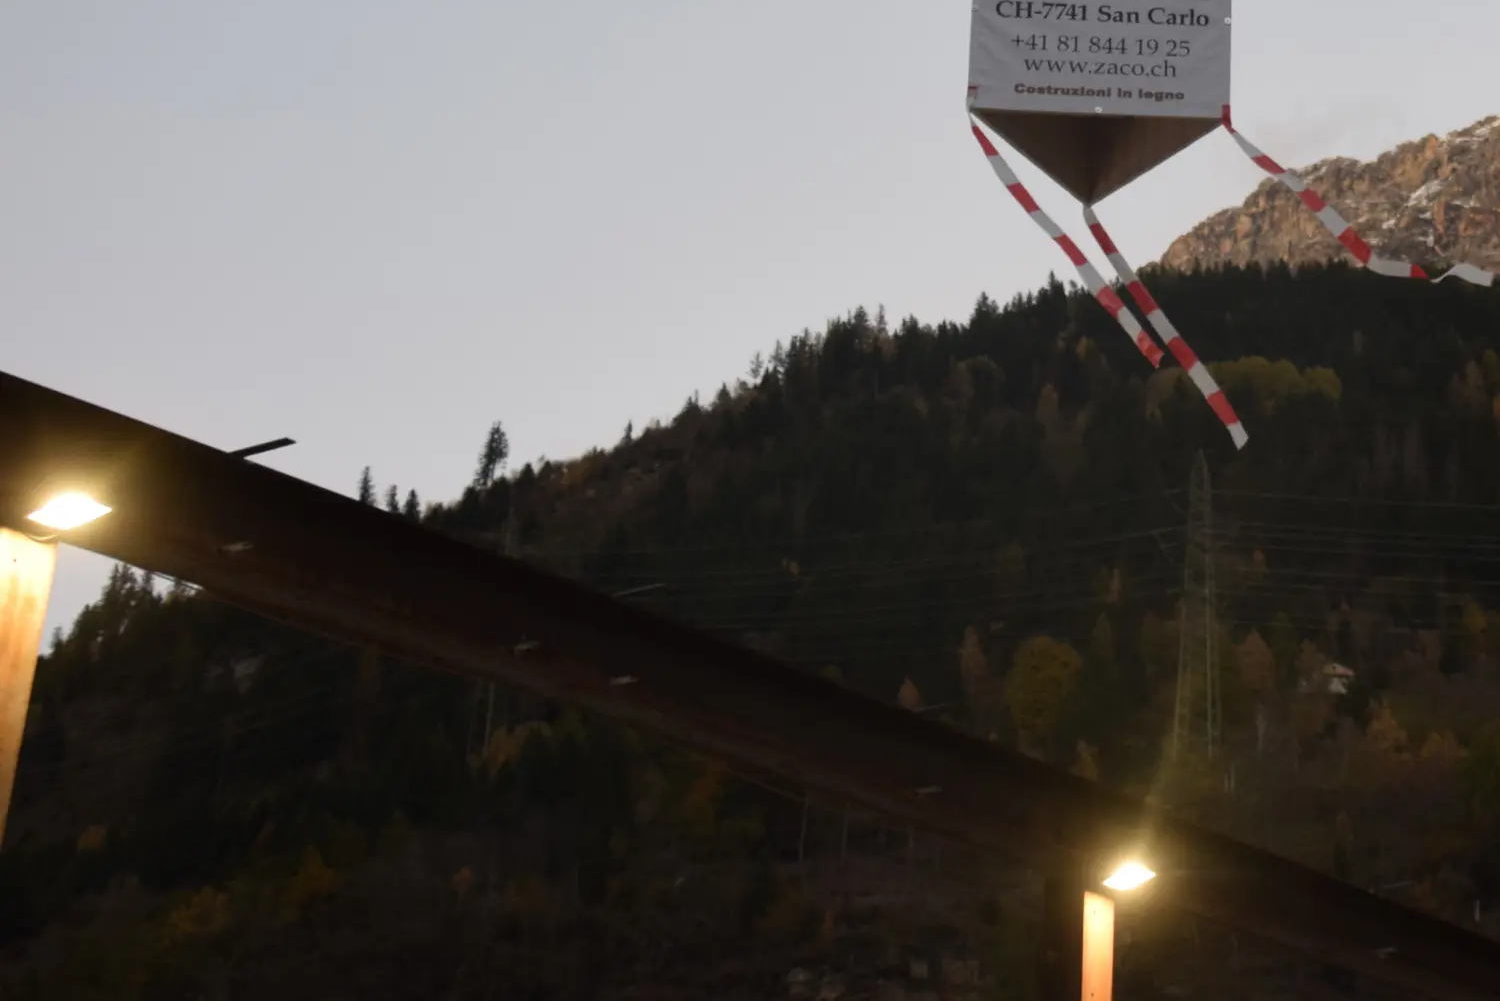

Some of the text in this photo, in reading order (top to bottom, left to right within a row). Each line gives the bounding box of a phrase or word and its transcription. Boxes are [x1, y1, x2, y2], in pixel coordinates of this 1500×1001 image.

[995, 0, 1210, 27] CH-7741 San Carlo
[1011, 33, 1191, 57] +41 81 844 19 25
[1024, 58, 1177, 78] www.zaco.ch
[1014, 83, 1185, 102] Costruzioni in legno
